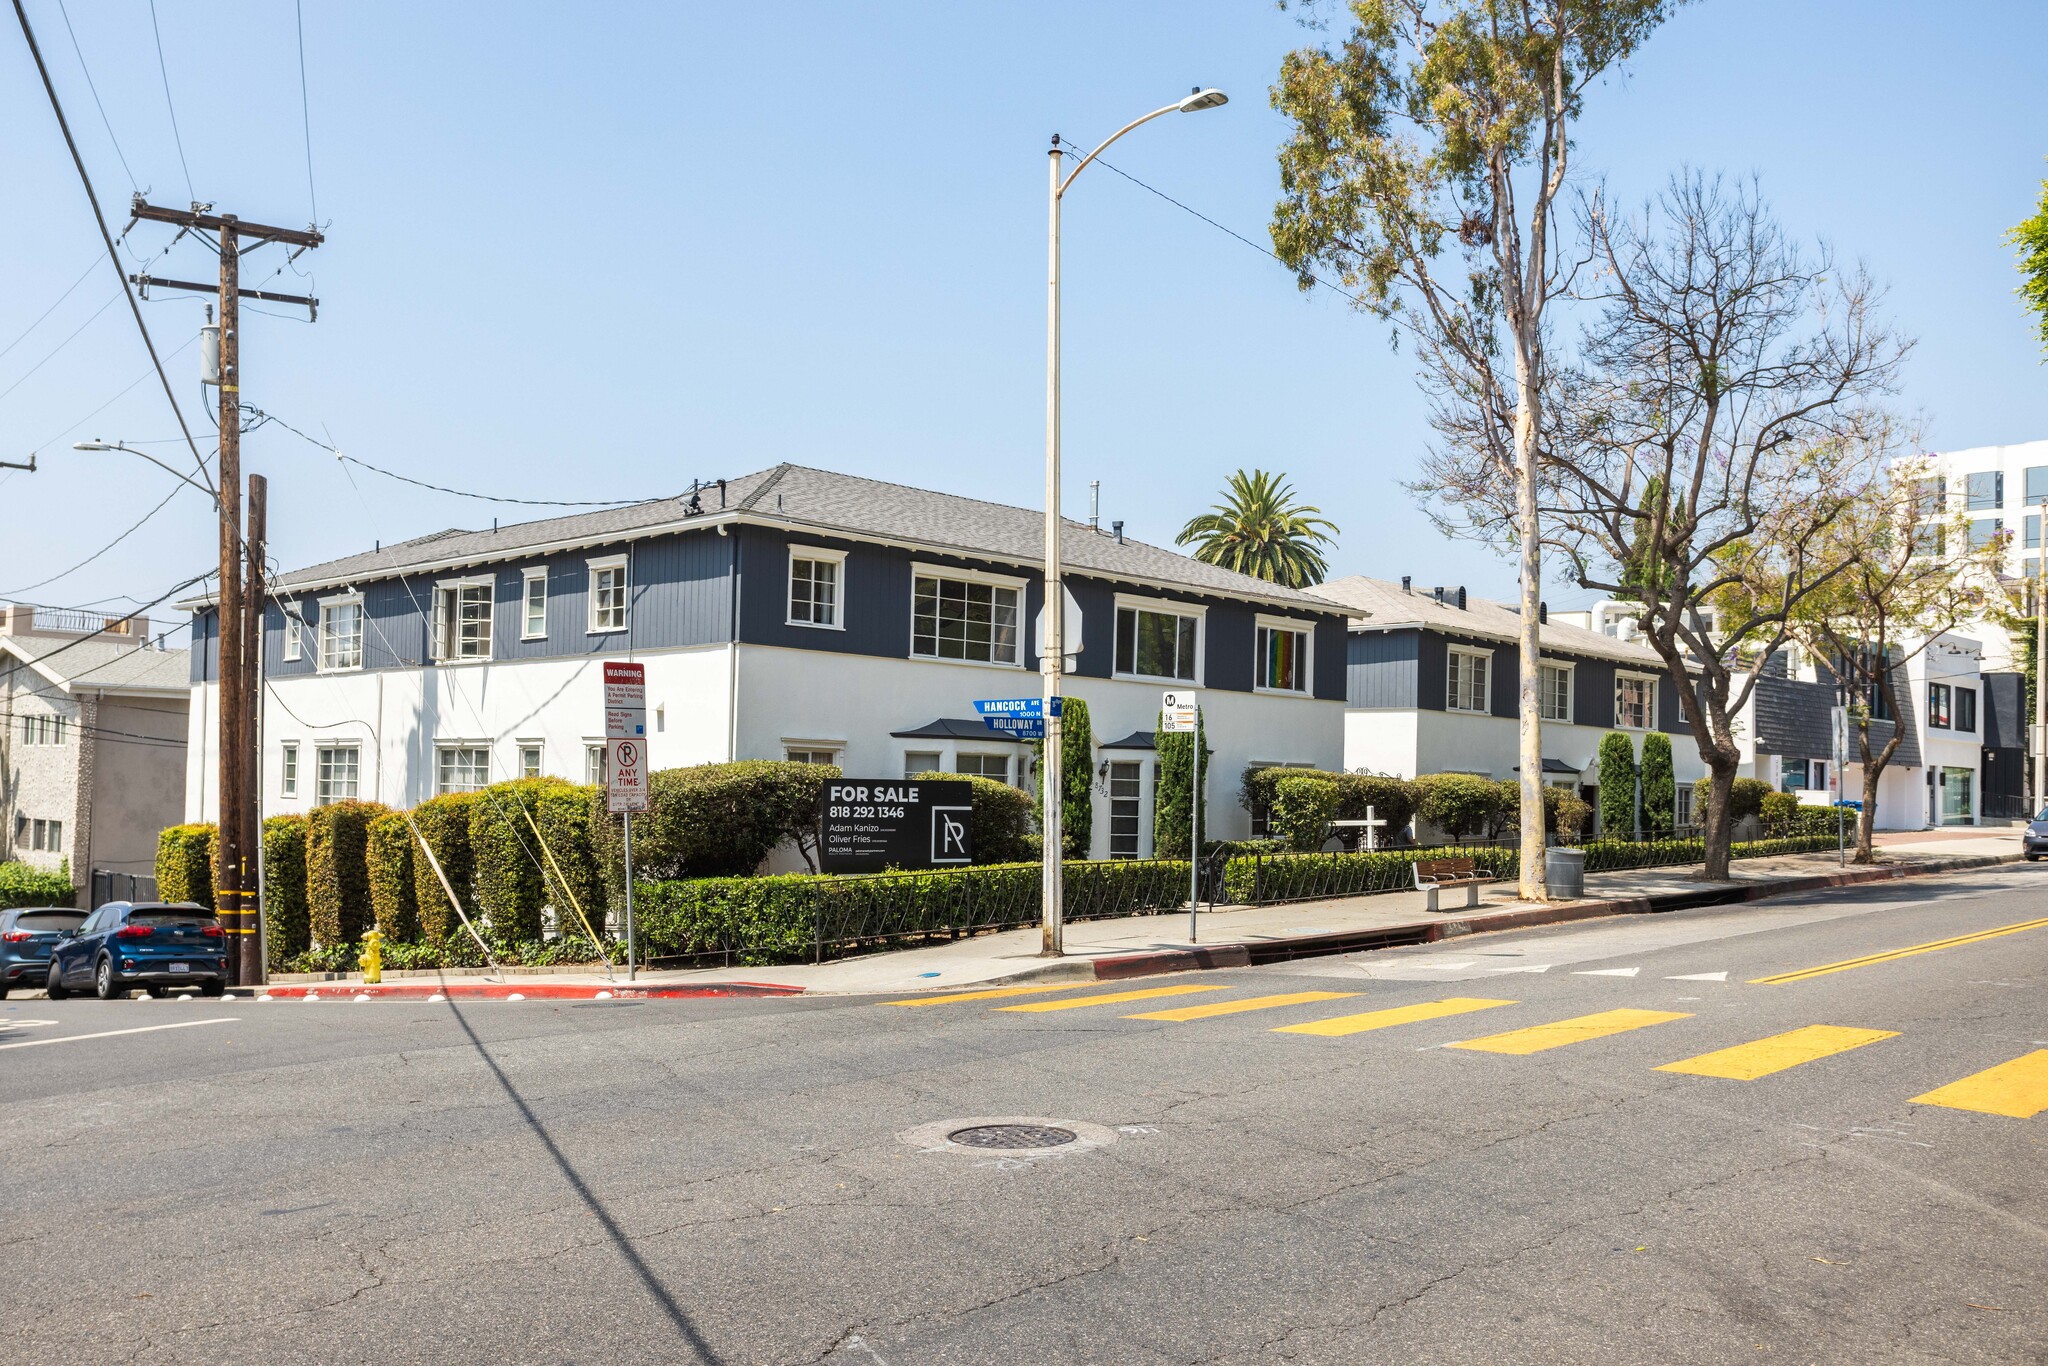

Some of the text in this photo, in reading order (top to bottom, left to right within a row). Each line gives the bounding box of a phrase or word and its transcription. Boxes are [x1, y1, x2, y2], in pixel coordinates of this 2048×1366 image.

[606, 669, 642, 678] WARNING
[984, 701, 1027, 712] HANCOCK
[993, 718, 1034, 730] HOLLOWAY
[618, 768, 638, 777] ANY
[617, 778, 639, 786] TIME
[830, 785, 919, 803] FOR SALE
[1094, 782, 1109, 798] 8732
[829, 806, 905, 818] 818 292 1346
[829, 824, 852, 832] Adam
[854, 824, 880, 832] Kanizo
[828, 834, 851, 843] Oliver
[852, 834, 871, 843] Fries
